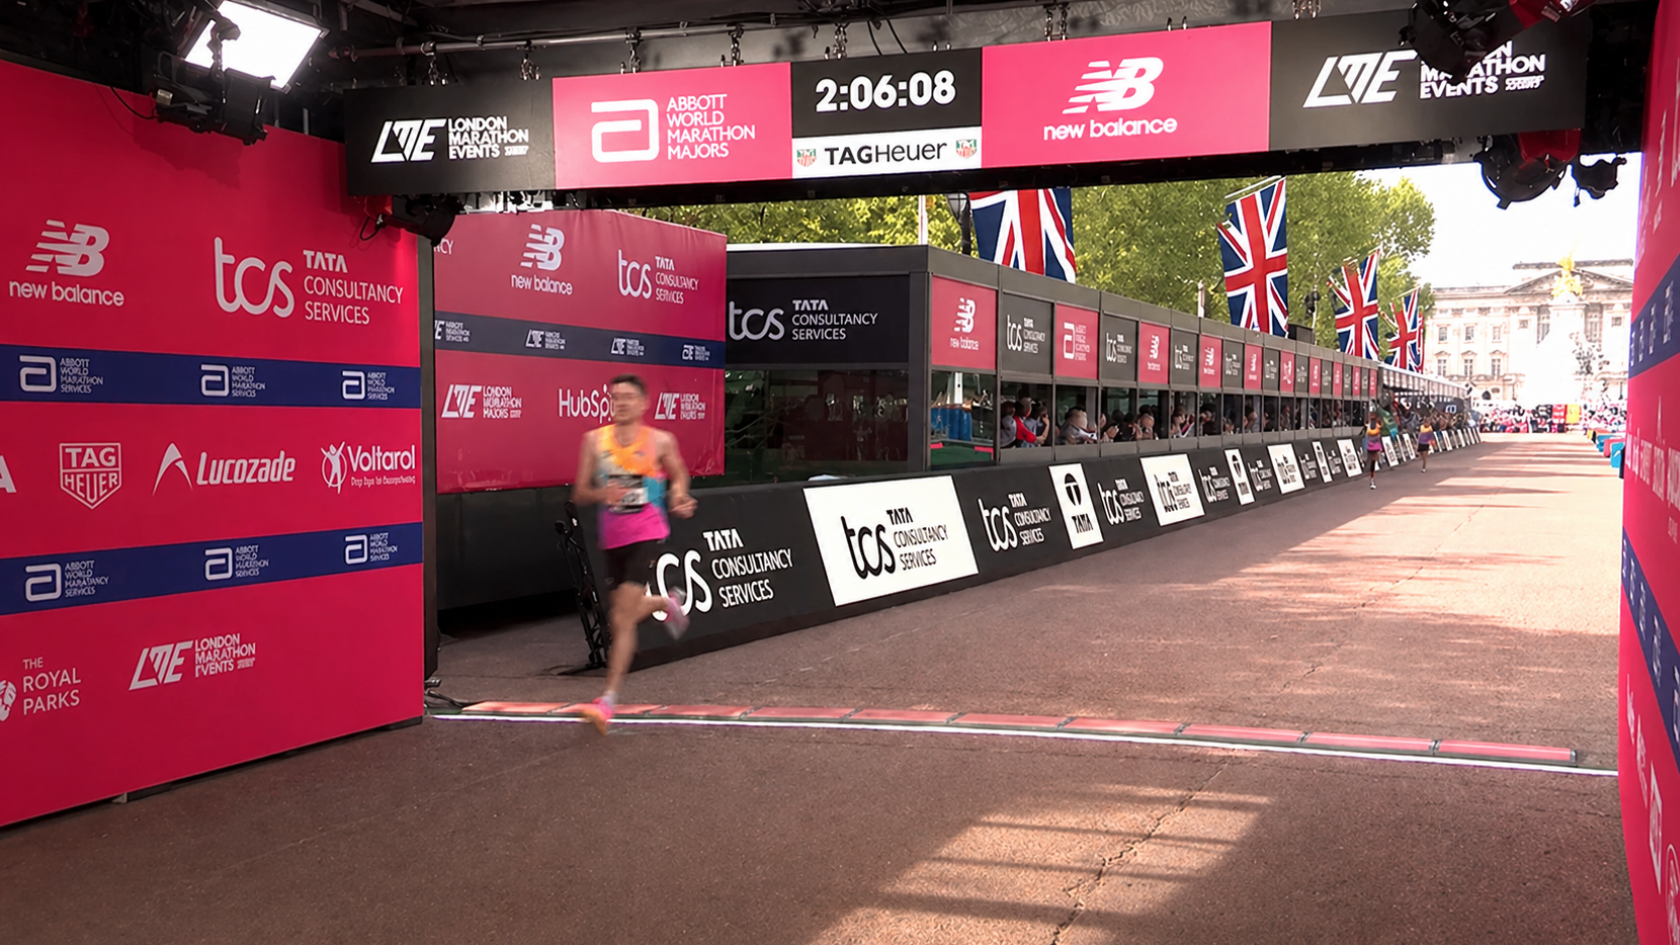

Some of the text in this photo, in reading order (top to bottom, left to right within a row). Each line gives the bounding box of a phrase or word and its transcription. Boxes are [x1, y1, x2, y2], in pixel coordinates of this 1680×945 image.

[815, 70, 956, 112] 2:06:08
[1420, 76, 1498, 99] EVENTS
[666, 94, 727, 112] ABBOTT
[448, 116, 507, 132] LONDON
[666, 110, 725, 127] WORLD
[1043, 117, 1178, 141] new balance
[448, 129, 529, 145] MARATHON
[667, 125, 755, 144] MARATHON
[449, 144, 500, 159] EVENTS
[667, 143, 729, 160] MAJORS
[303, 250, 348, 273] TATA
[655, 256, 675, 271] TATA
[214, 236, 295, 317] tcs
[511, 274, 573, 296] new balance
[618, 249, 652, 299] tcs
[9, 280, 124, 306] new balance
[304, 275, 403, 304] CONSULTANCY
[305, 301, 370, 324] SERVICES
[792, 300, 829, 312] TATA
[729, 301, 785, 341] tcs
[792, 312, 878, 326] CONSULTANCY
[792, 328, 846, 341] SERVICES
[1007, 314, 1022, 352] tcs
[558, 386, 616, 424] HubSp
[65, 447, 116, 468] TAG
[196, 450, 296, 485] Lucozade
[347, 444, 415, 472] Voltarol
[65, 473, 118, 504] HEUER
[1008, 492, 1028, 508] TATA
[1097, 482, 1125, 526] tcs
[886, 507, 914, 525] TATA
[978, 498, 1018, 552] tcs
[702, 528, 744, 551] TATA
[840, 516, 896, 580] tcs
[893, 524, 949, 549] CONSULTANCY
[711, 548, 793, 580] CONSULTANCY
[899, 548, 937, 571] SERVICES
[644, 550, 713, 621] cs
[718, 579, 774, 608] SERVICES
[195, 633, 240, 652] LONDON
[195, 643, 256, 665] MARATHON
[23, 657, 43, 670] THE
[23, 667, 81, 693] ROYAL
[23, 689, 80, 716] PARKS
